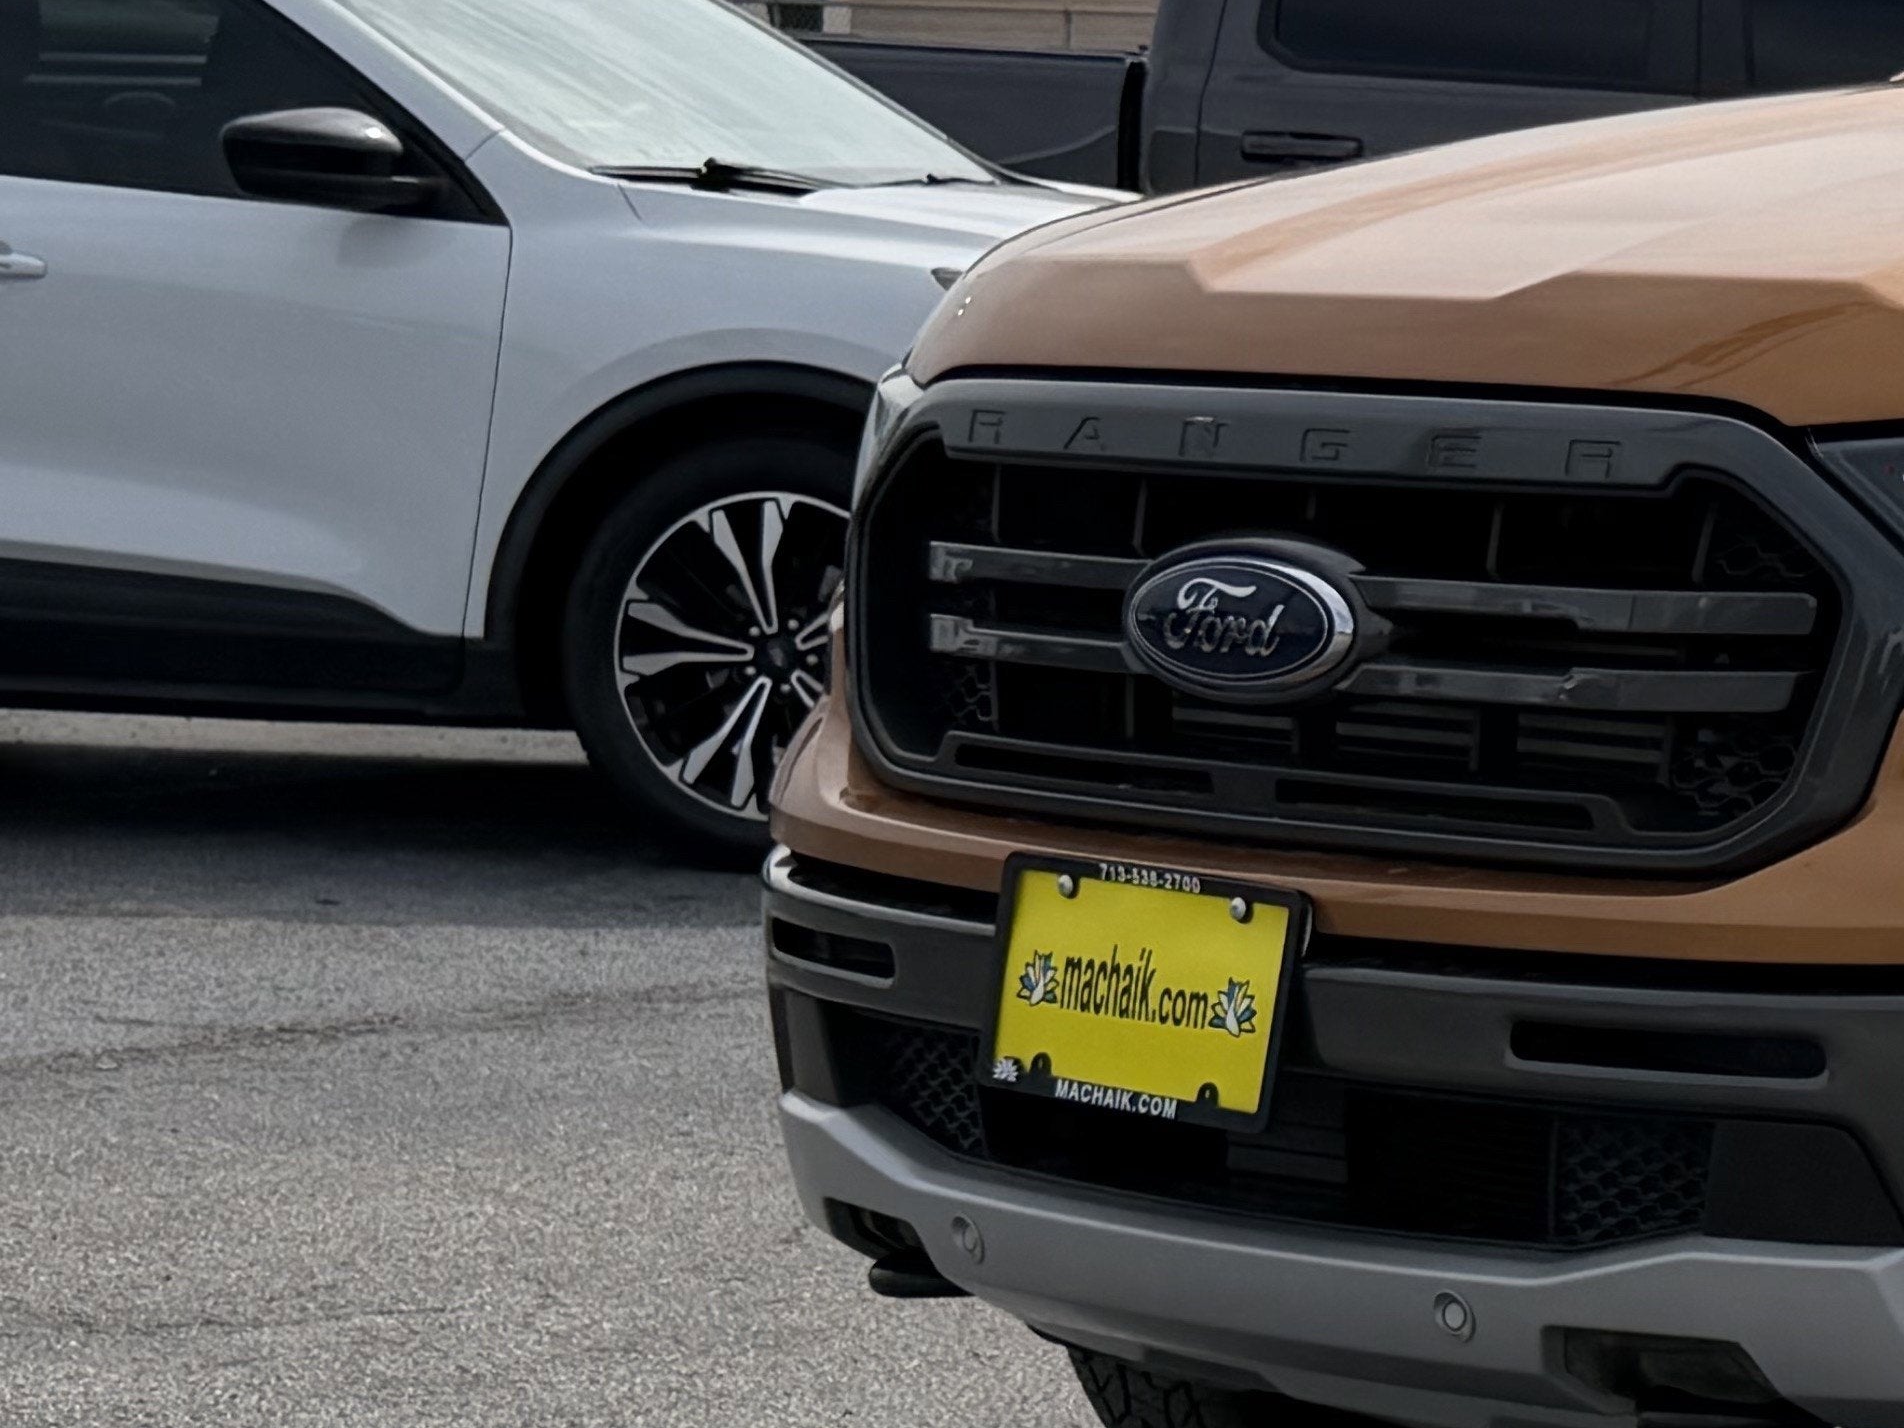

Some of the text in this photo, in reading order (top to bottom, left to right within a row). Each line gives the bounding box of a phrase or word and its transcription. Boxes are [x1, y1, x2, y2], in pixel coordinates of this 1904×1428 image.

[967, 408, 1623, 479] RANGER
[1163, 577, 1285, 656] Ford
[1059, 943, 1209, 1029] machaik.com
[1054, 1078, 1178, 1120] MACHAIK.COM
